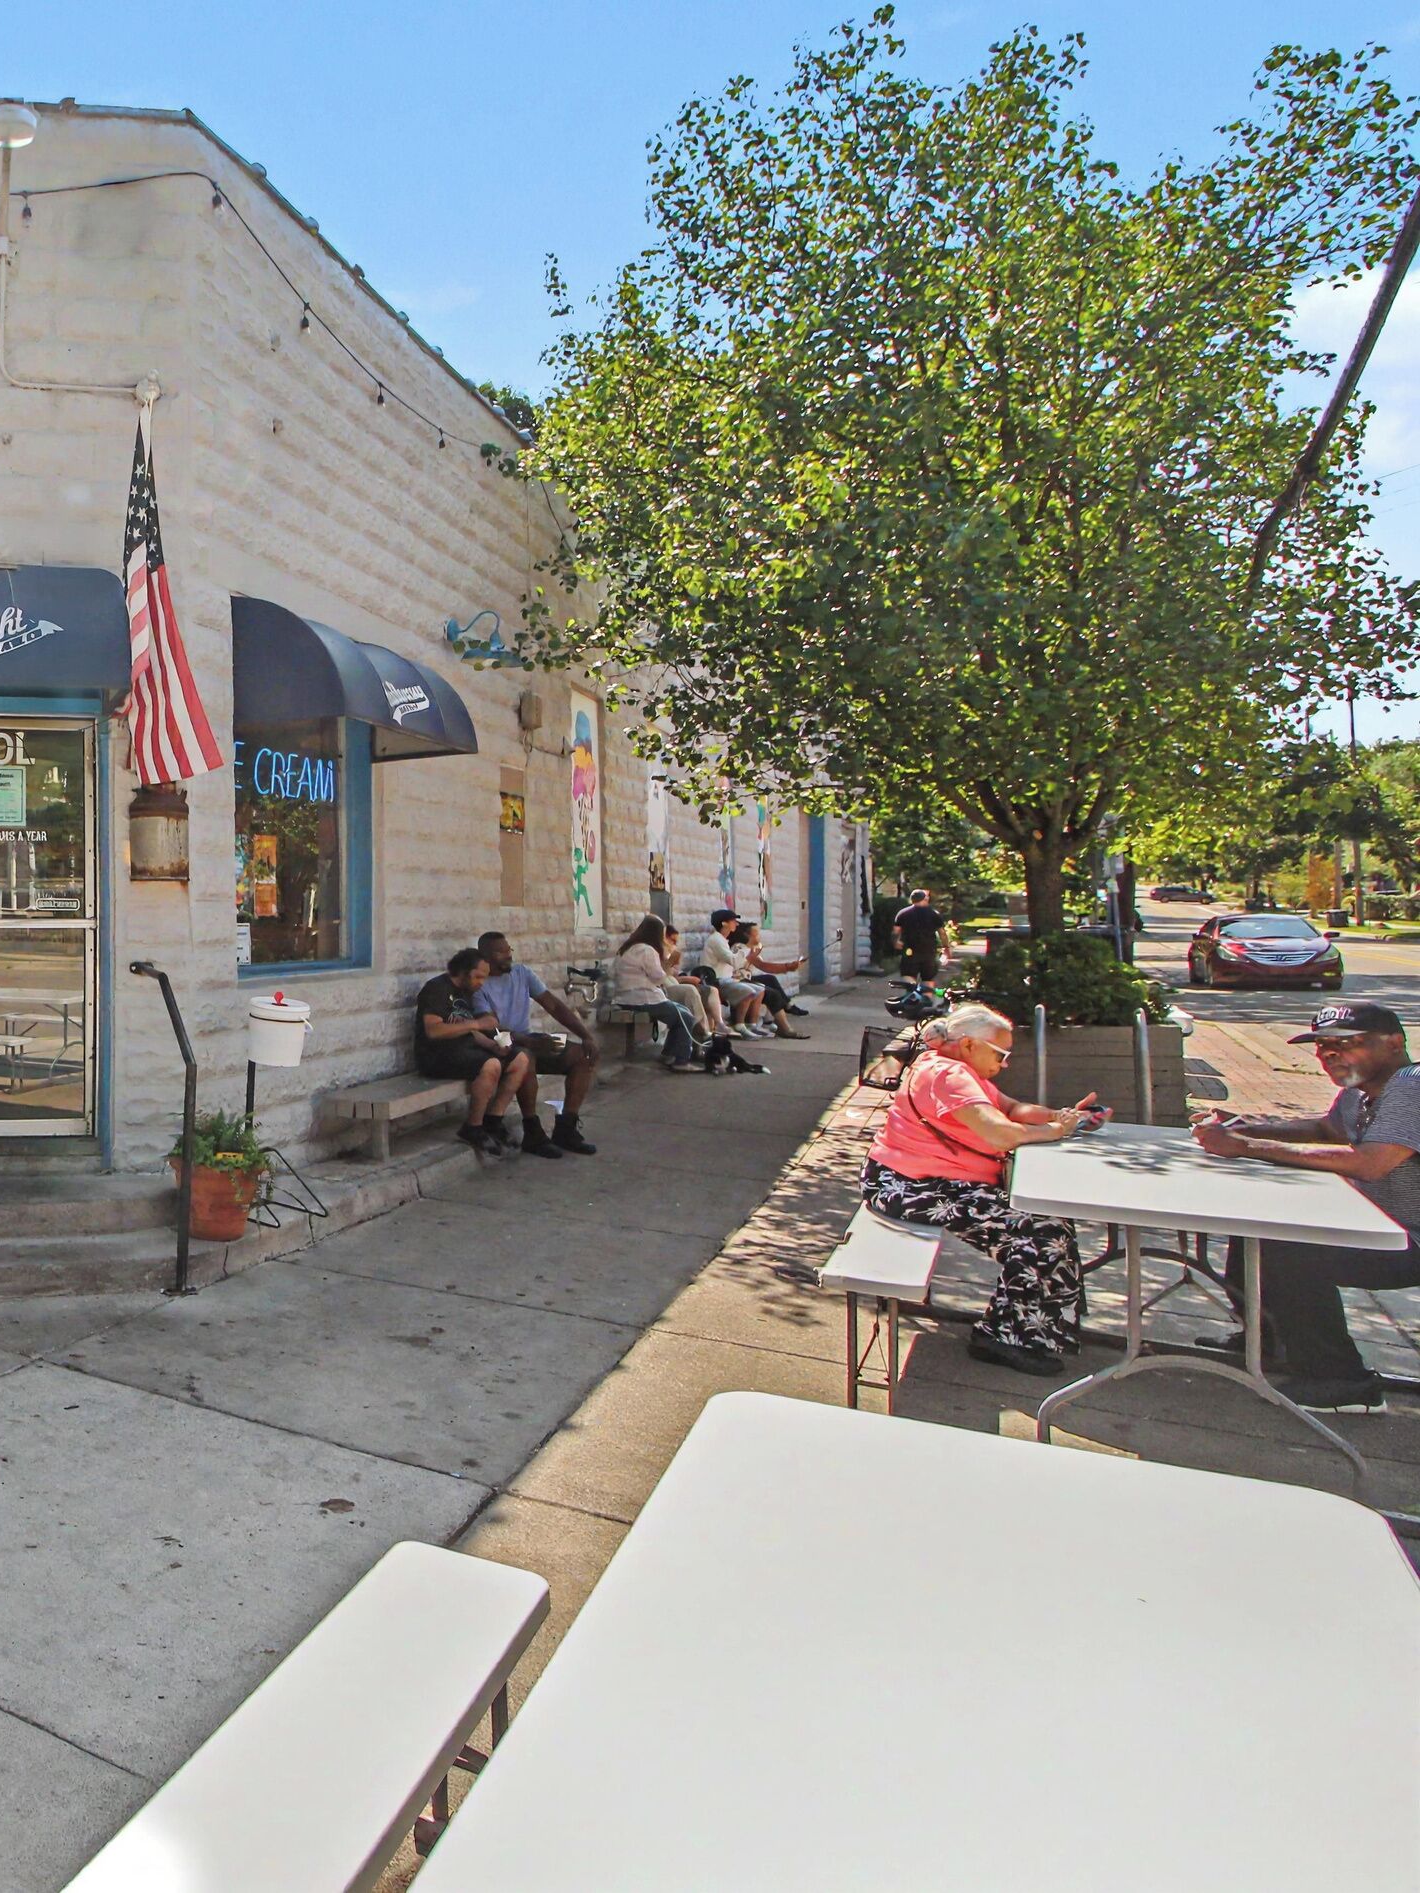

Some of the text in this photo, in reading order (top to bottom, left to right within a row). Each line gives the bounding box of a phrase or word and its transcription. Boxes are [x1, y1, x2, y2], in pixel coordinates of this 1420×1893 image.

[254, 747, 335, 804] CREAM
[17, 831, 24, 841] A
[26, 830, 48, 842] YEAR
